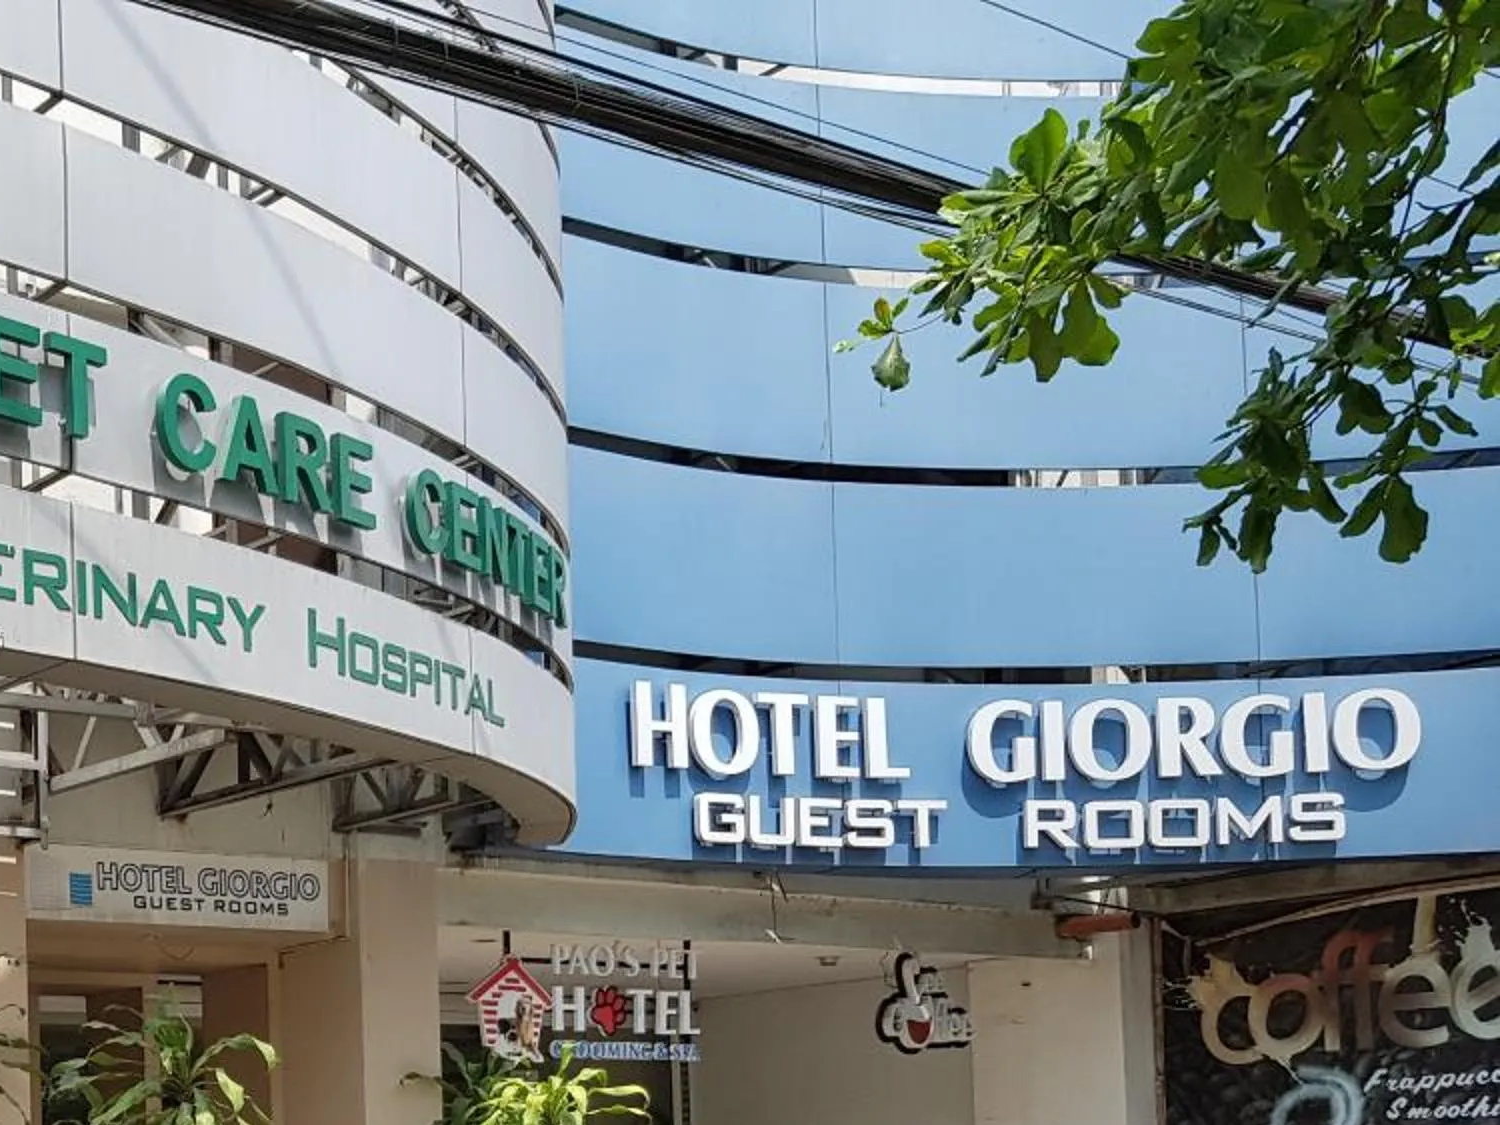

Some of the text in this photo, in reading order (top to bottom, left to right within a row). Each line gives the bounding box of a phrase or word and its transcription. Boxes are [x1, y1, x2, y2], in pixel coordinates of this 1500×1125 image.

[156, 373, 377, 531] CARE
[405, 467, 568, 630] CENTER
[307, 607, 506, 728] HOSPITAL
[628, 679, 1423, 785] HOTEL GIORGIO
[692, 790, 1348, 850] GUEST ROOMS
[96, 861, 321, 901] HOTEL GIORGIO
[133, 895, 290, 916] GUEST ROOMS
[551, 939, 698, 979] PAO'S PET
[549, 1039, 652, 1061] GOOMING
